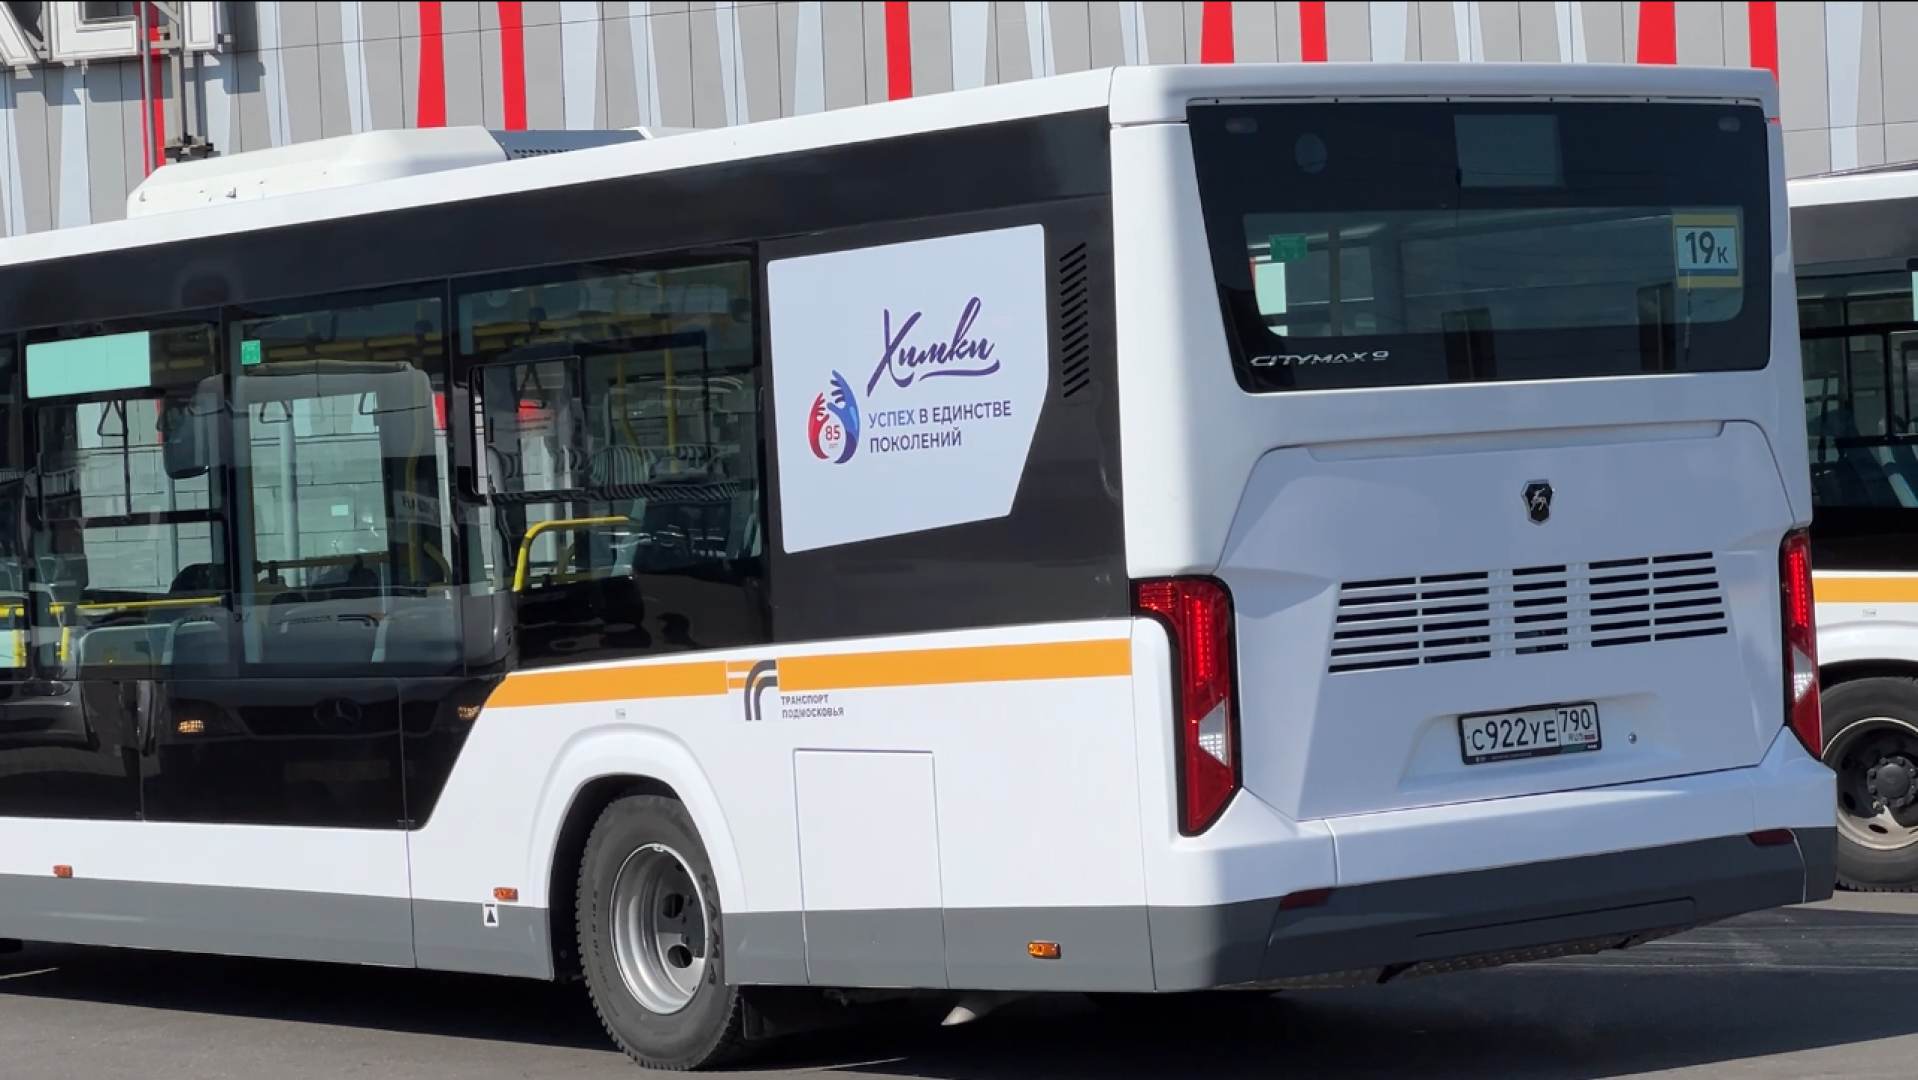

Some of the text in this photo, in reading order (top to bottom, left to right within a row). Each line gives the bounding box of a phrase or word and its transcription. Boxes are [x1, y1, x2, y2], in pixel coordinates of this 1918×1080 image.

[867, 297, 1001, 397] Химки
[1250, 350, 1389, 367] CITYMAX 9
[868, 400, 1012, 429] УСПЕХ В ЕДИНСТВЕ
[825, 425, 841, 441] 85
[870, 427, 962, 453] ПОКОЛЕНИЙ
[781, 694, 829, 705] ТРАНСПОРТ
[782, 706, 845, 720] ПОДМОСКОВЬЯ
[1559, 708, 1592, 732] 790
